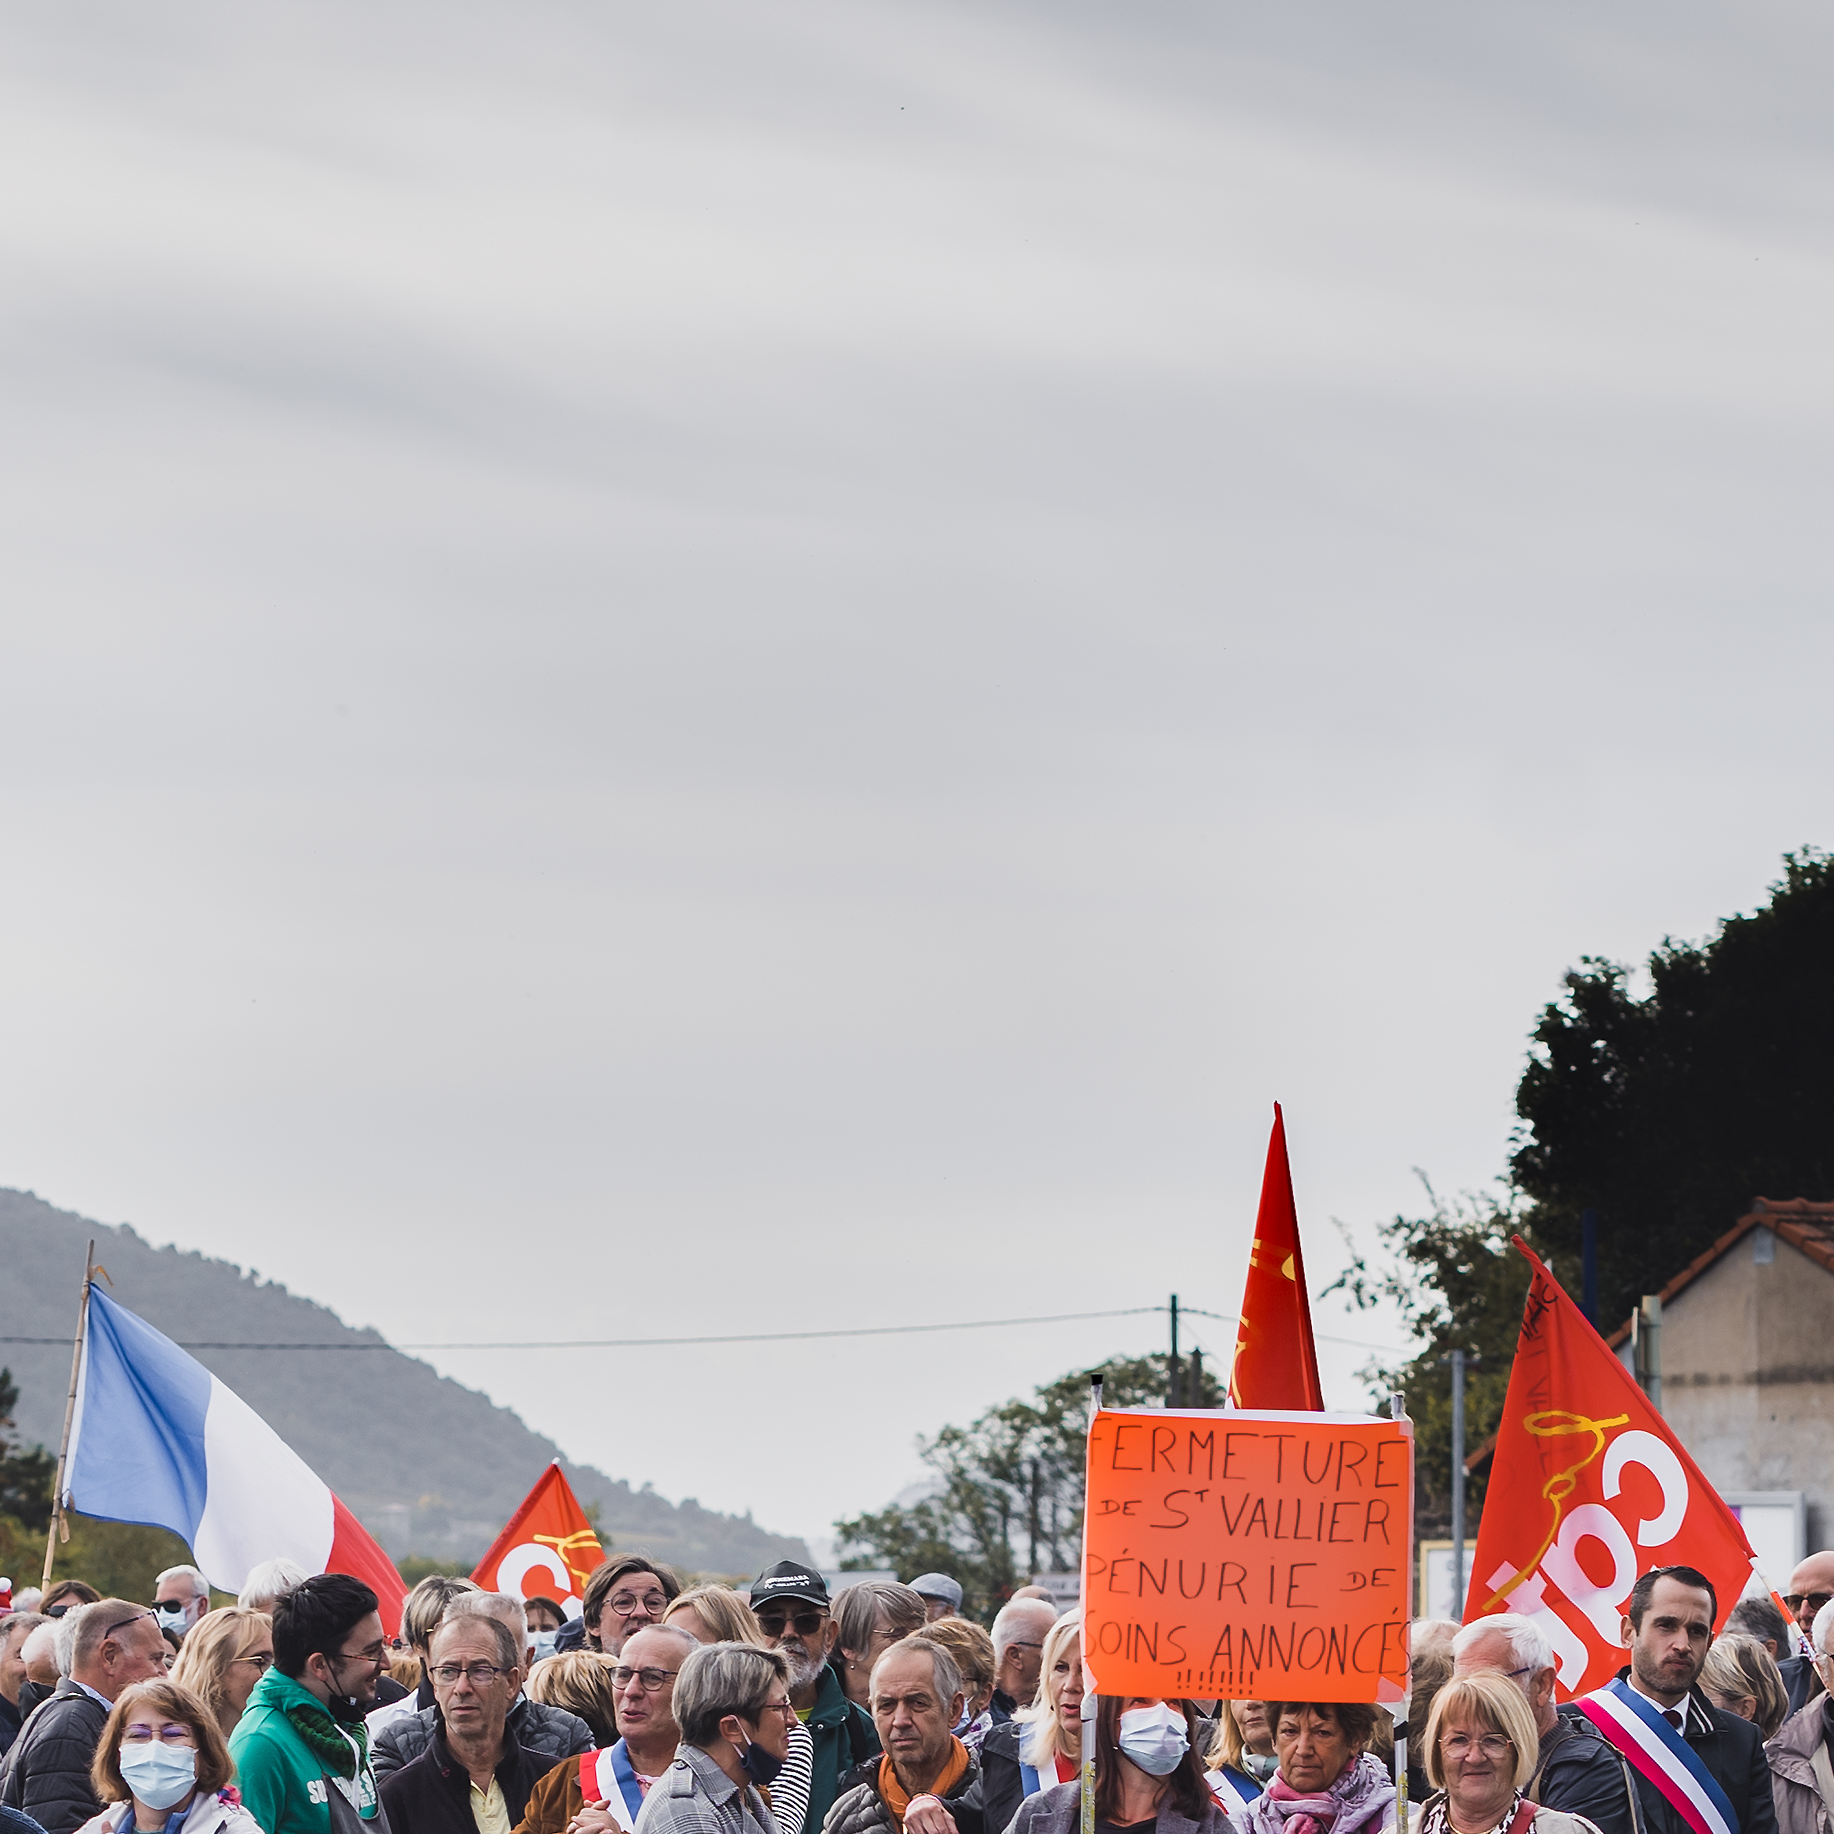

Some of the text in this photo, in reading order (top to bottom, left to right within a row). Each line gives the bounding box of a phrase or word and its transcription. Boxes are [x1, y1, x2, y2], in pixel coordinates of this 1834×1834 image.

[1091, 1417, 1407, 1492] FERMETURE
[1096, 1499, 1142, 1517] DE
[1220, 1492, 1390, 1546] VALLIER
[1086, 1548, 1396, 1609] PÉNURIE DE
[1083, 1607, 1412, 1677] SOINS ANNONCÉS
